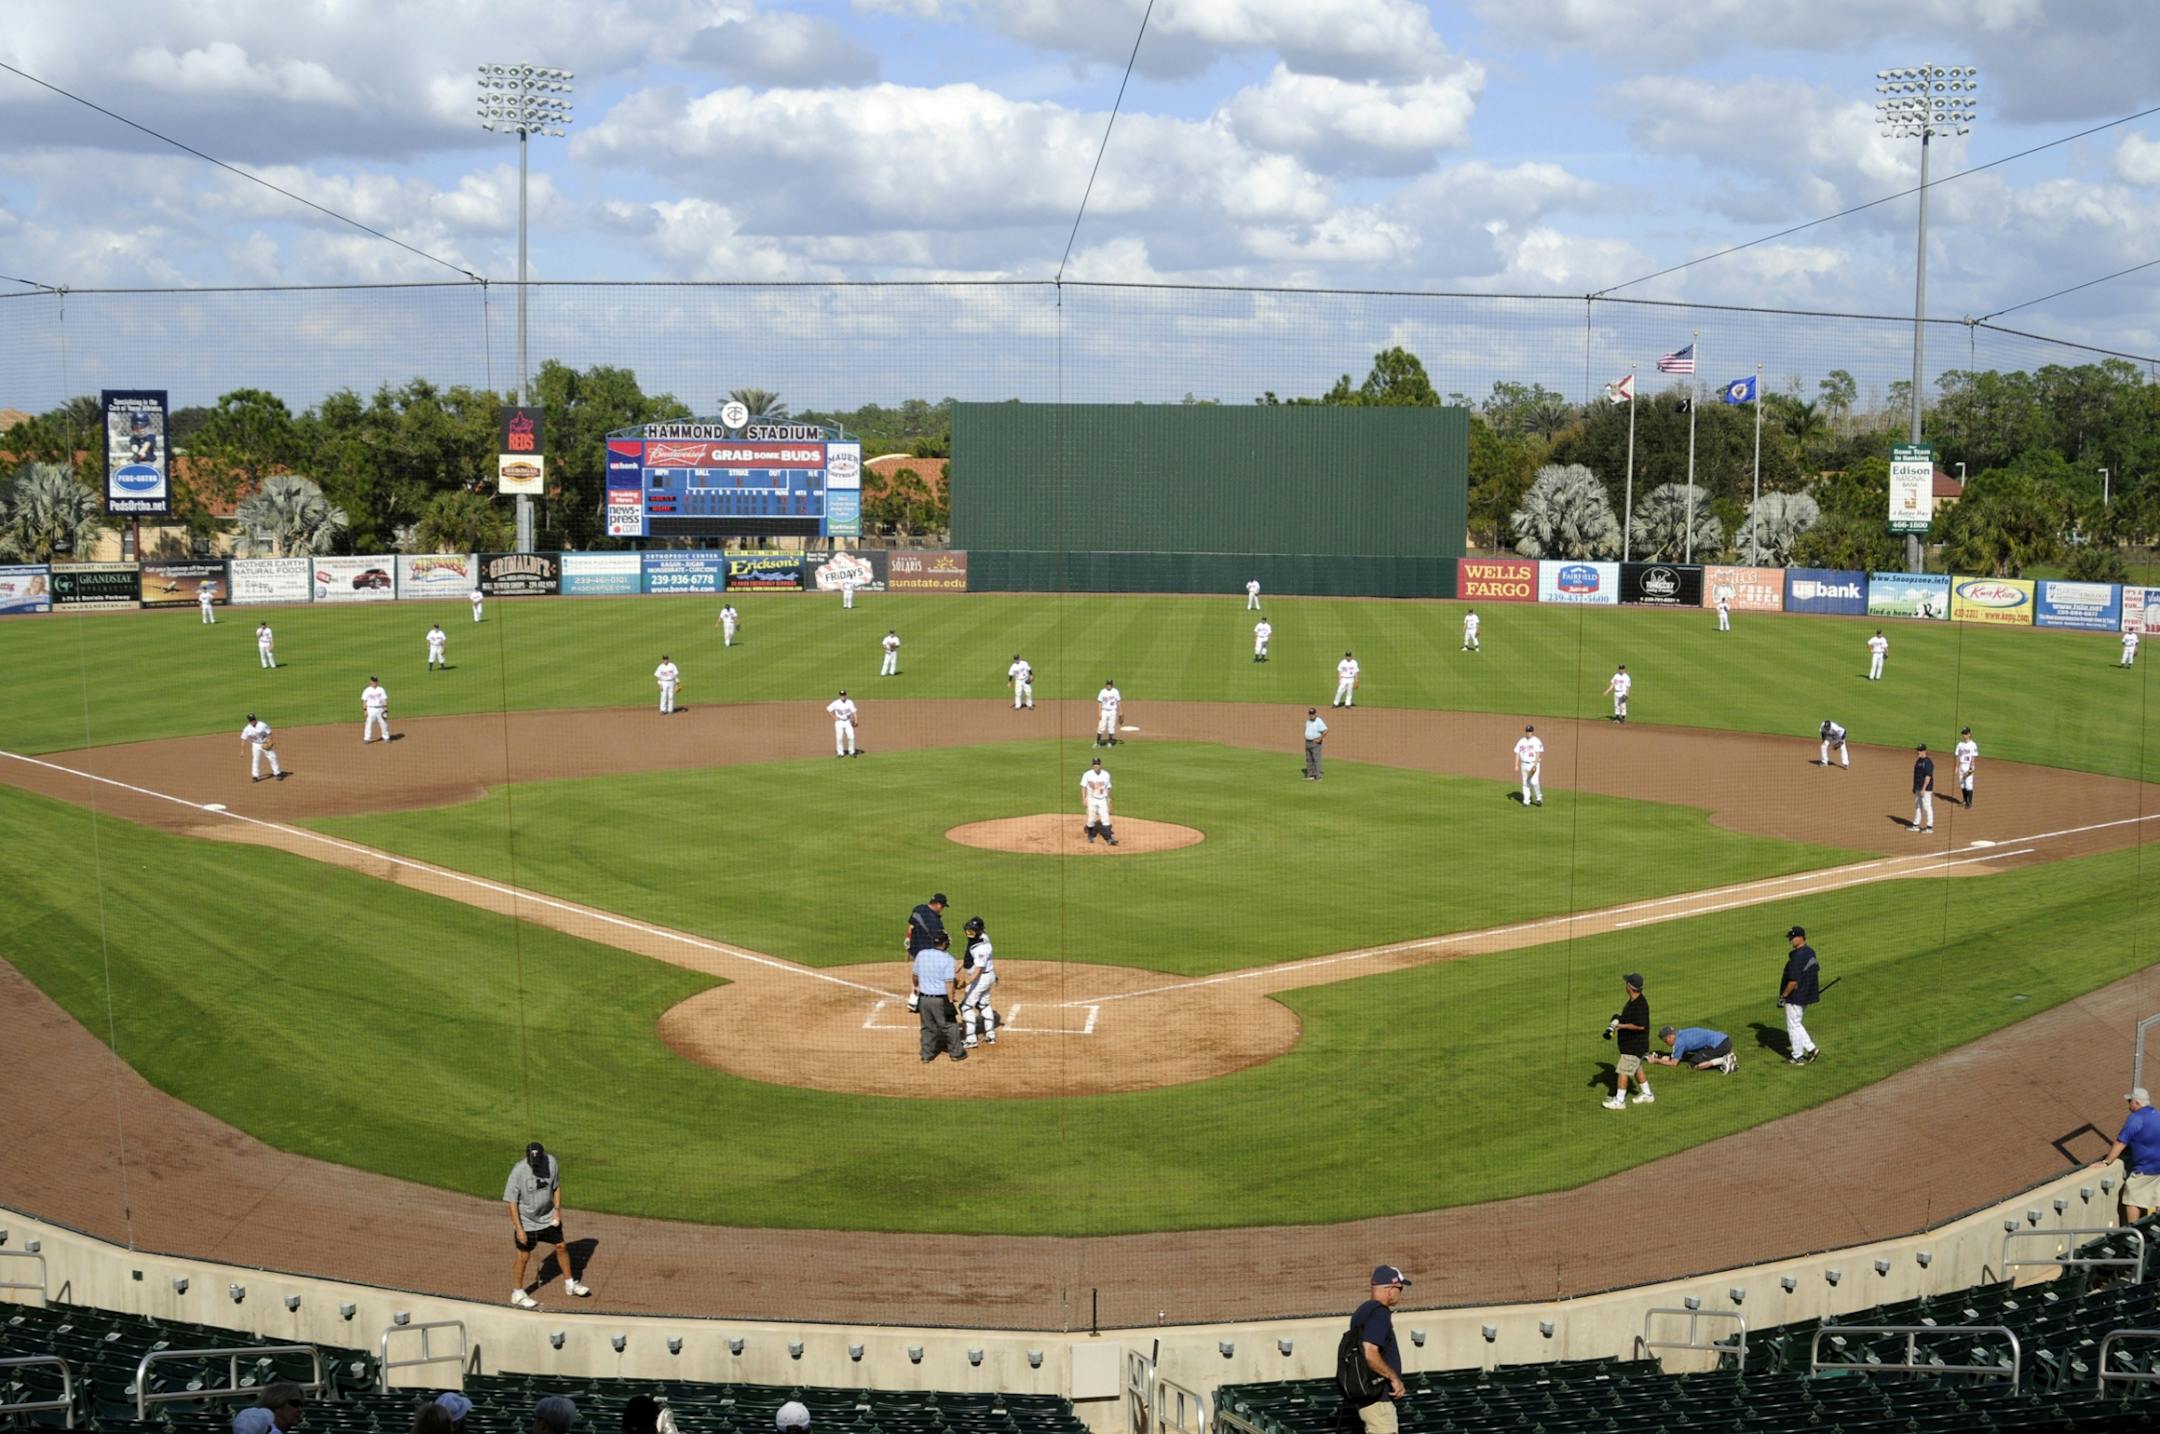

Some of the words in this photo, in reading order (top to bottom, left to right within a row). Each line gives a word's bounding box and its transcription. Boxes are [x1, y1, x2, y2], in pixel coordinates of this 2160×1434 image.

[647, 424, 724, 440] HAMMOND
[748, 425, 819, 441] STADIUM
[711, 449, 753, 461] GRAB
[781, 450, 820, 461] BUDS
[1893, 466, 1930, 475] Edison
[609, 506, 640, 515] news-
[609, 515, 640, 526] press
[274, 559, 305, 568] EARTH
[728, 556, 800, 576] Erickson's
[233, 567, 274, 575] NATURAL
[276, 566, 307, 574] FOODS
[1464, 565, 1532, 580] WELLS
[651, 574, 714, 584] 239-936-6778
[1562, 572, 1598, 581] FAIRFIELD
[888, 578, 966, 588] sunstate.edu
[1465, 582, 1530, 597] FARGO
